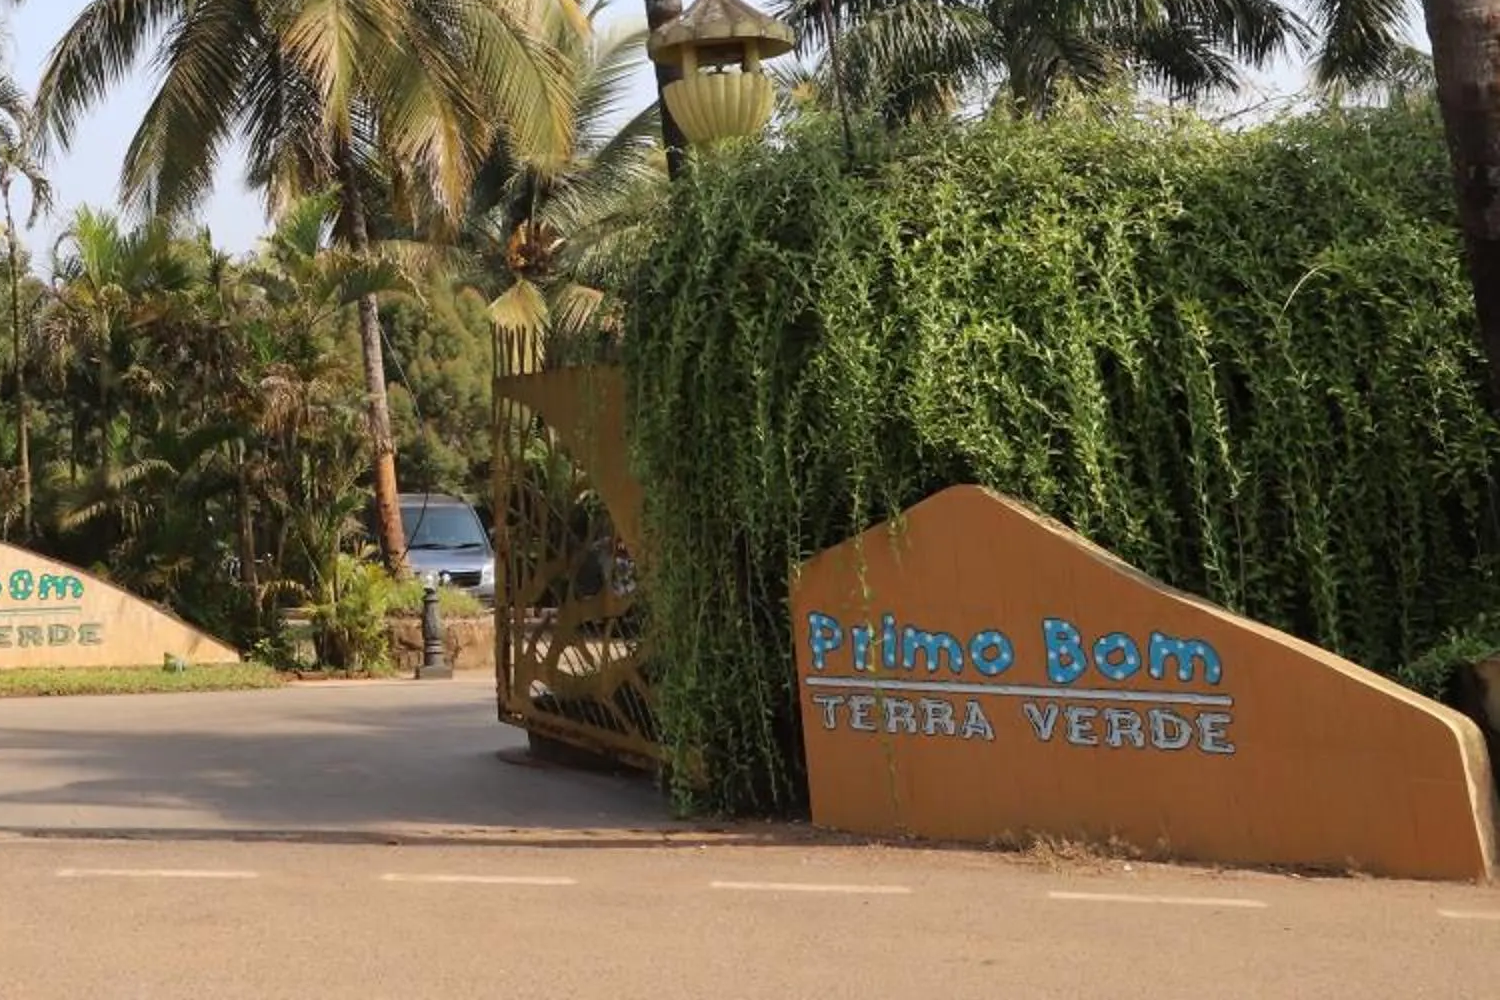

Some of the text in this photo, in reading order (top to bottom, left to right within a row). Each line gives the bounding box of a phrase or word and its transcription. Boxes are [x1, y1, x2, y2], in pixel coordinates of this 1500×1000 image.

[807, 611, 1223, 685] Primo Bom
[812, 694, 1236, 755] TERRA VERDE
